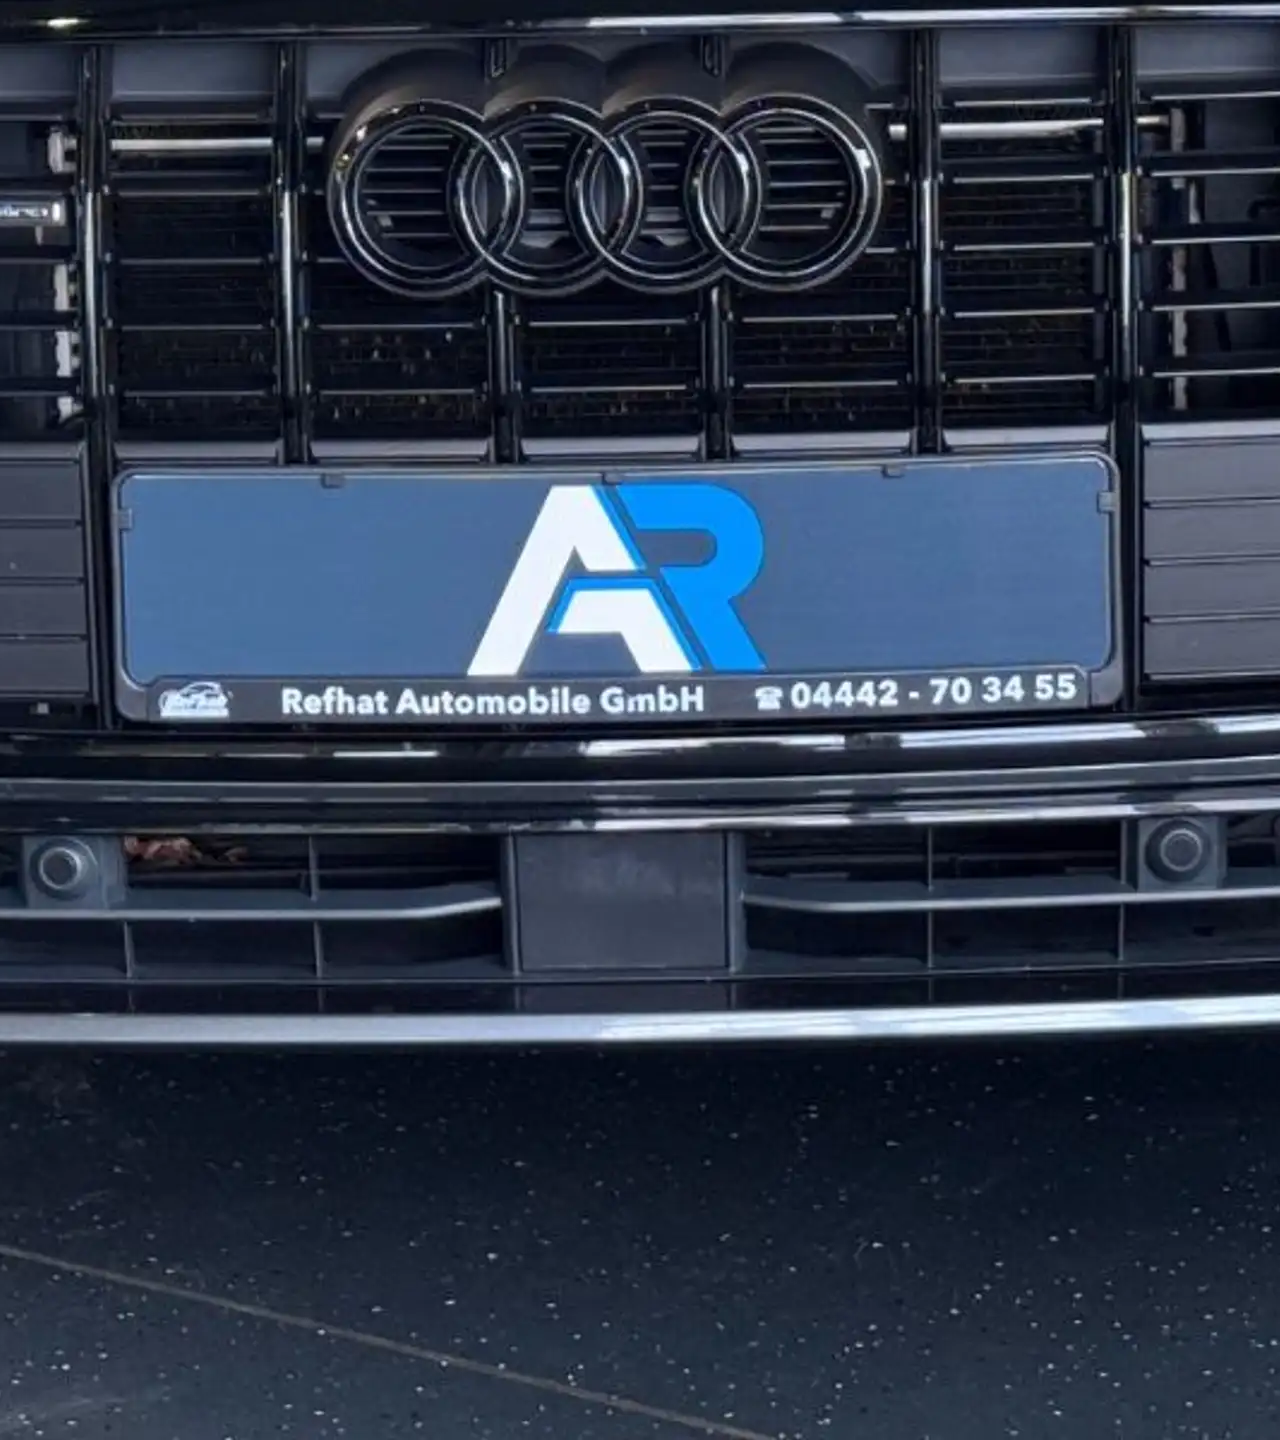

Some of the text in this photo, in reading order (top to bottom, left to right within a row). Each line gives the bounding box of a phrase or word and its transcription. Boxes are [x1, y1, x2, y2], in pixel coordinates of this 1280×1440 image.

[466, 483, 767, 676] AR
[281, 684, 704, 715] Refhat Automobile GmbH
[790, 679, 899, 710] 04442
[929, 676, 972, 705] 70
[981, 675, 1025, 703] 34
[1034, 673, 1077, 701] 55
